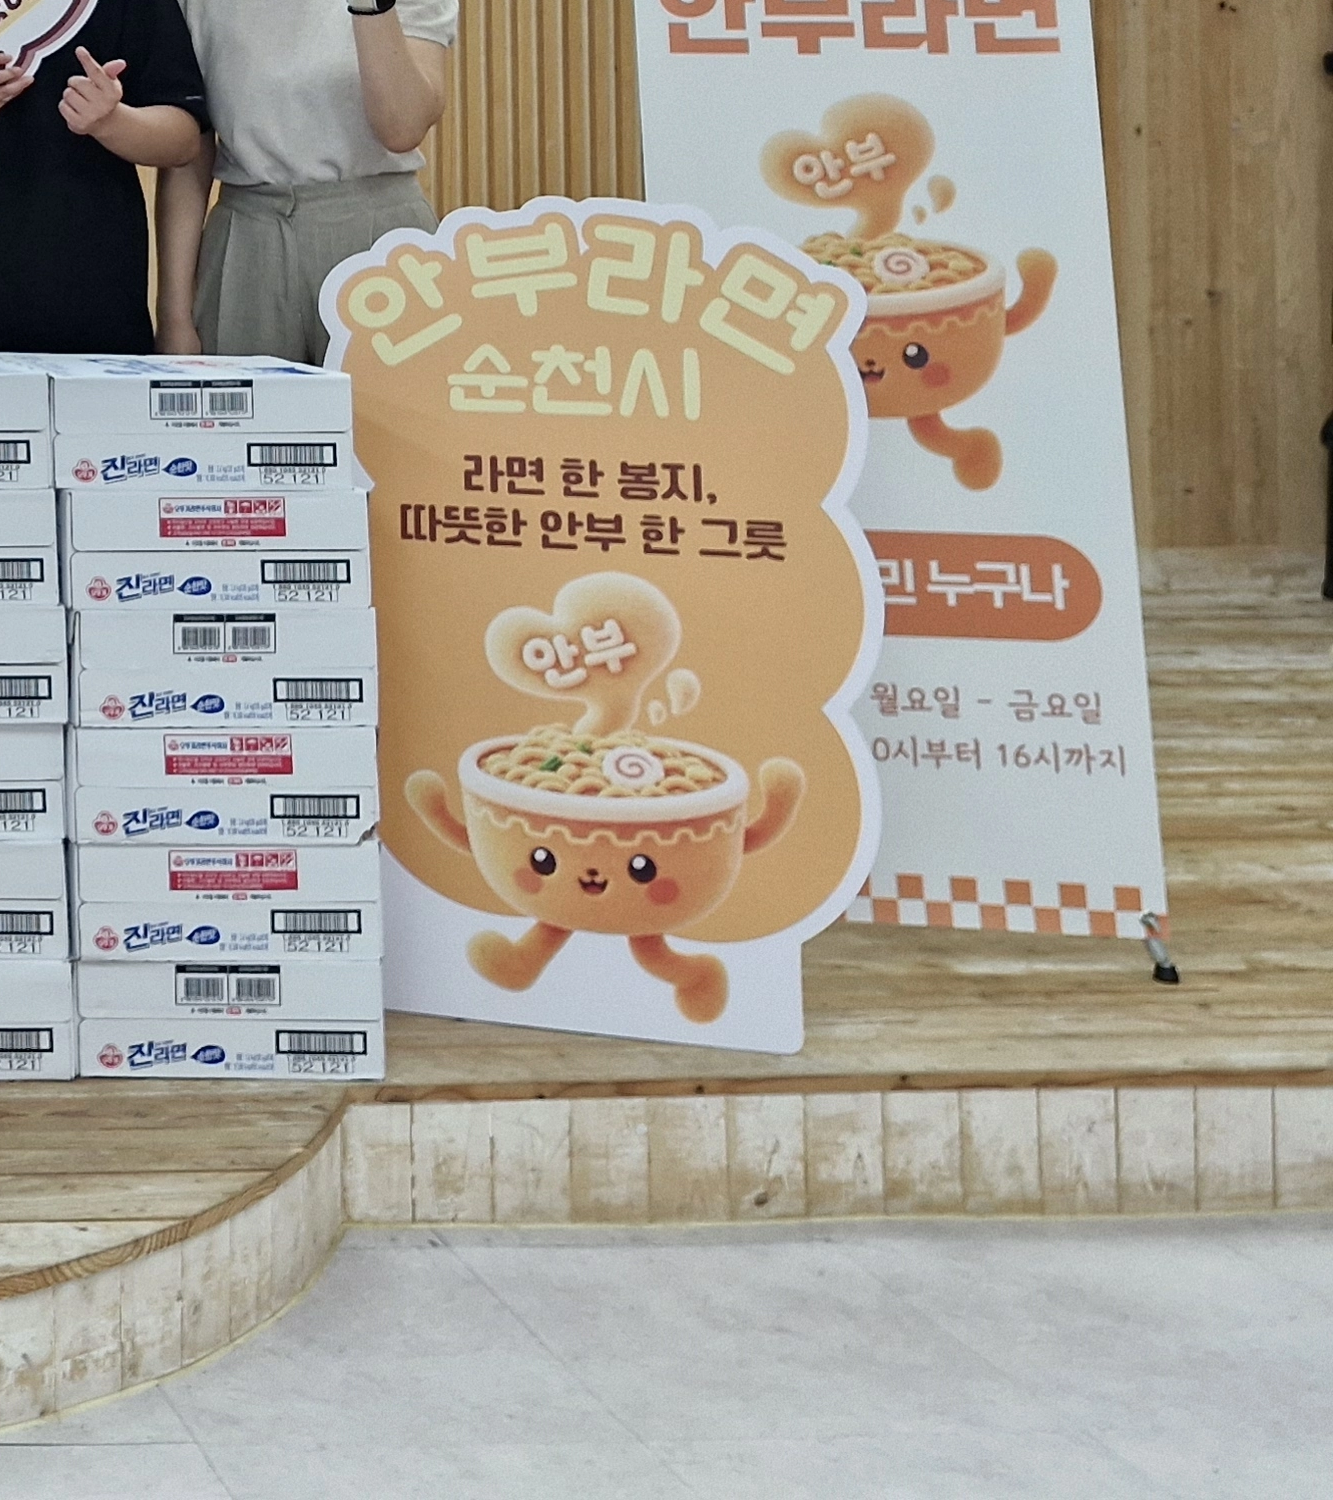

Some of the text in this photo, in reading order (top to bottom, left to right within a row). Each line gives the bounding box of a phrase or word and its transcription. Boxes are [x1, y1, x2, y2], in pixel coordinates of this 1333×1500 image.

[792, 133, 896, 199] 안부
[348, 222, 836, 376] 안부라면
[448, 344, 701, 420] 순천시
[102, 456, 160, 483] 진라면
[463, 454, 717, 506] 라면 한 봉지,
[400, 503, 787, 562] 따뜻한 안부 한 그릇
[117, 575, 174, 602] 진라면
[927, 559, 1070, 611] 누구나
[522, 619, 638, 687] 안부
[130, 693, 186, 720] 진라면
[870, 682, 960, 719] 월요일
[1008, 689, 1102, 725] 금요일
[998, 742, 1126, 776] 16시까지
[123, 808, 182, 836] 진라면
[124, 923, 182, 950] 진라면
[129, 1044, 186, 1069] 진라면
